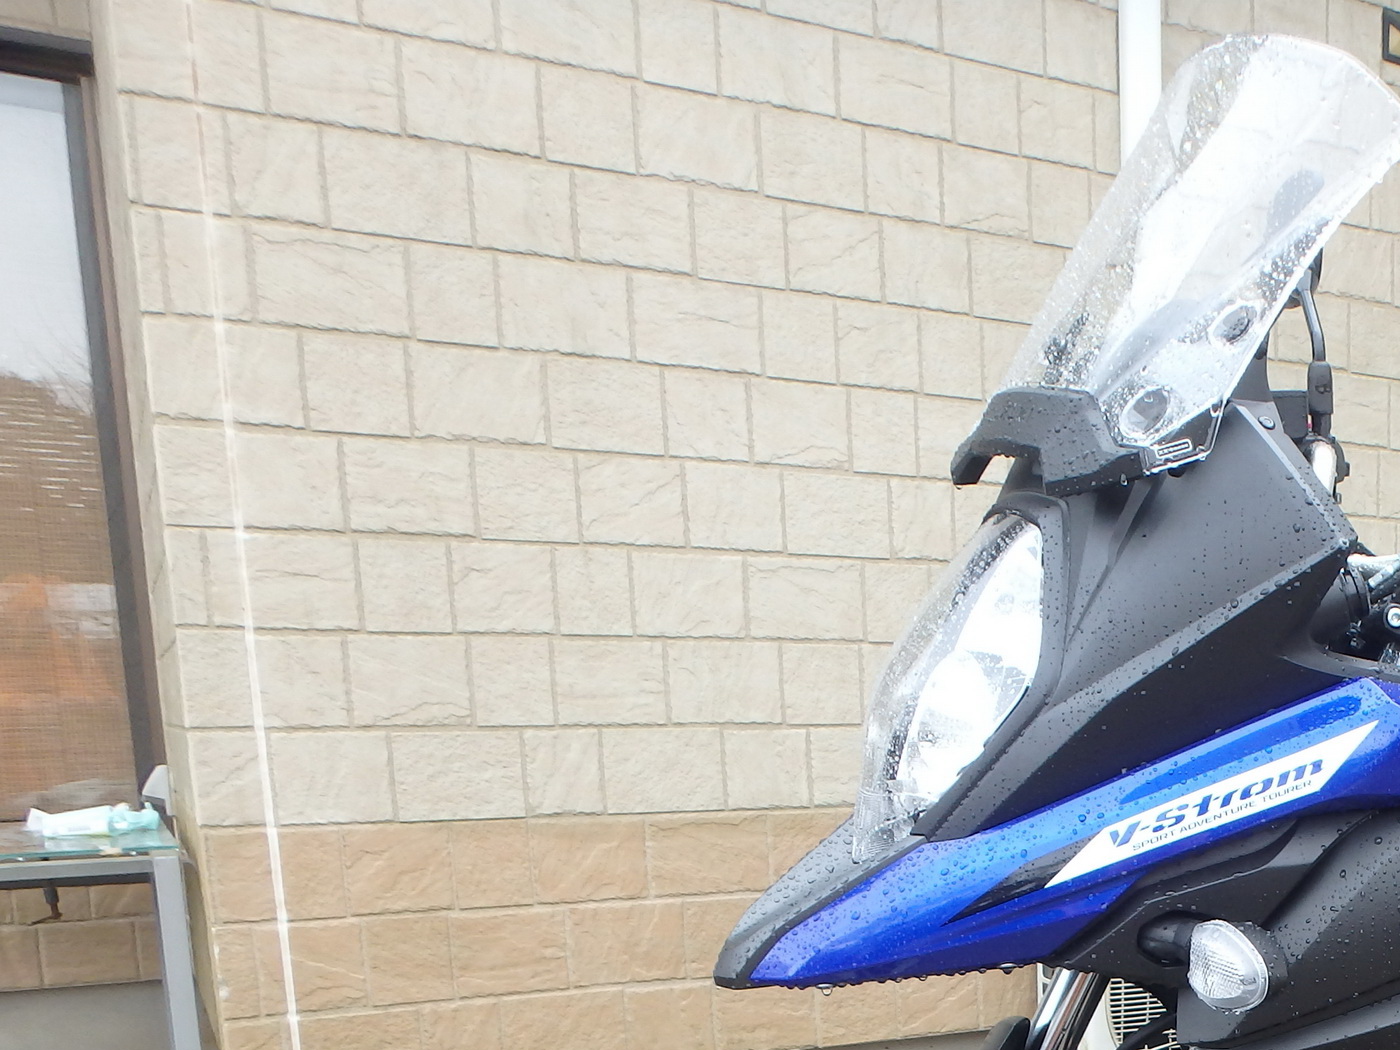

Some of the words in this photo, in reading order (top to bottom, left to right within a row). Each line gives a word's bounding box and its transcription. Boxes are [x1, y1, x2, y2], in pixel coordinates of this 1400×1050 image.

[1109, 758, 1324, 847] V-Strom
[1132, 830, 1175, 851] SPORT
[1179, 800, 1258, 834] ADVENTURE
[1262, 779, 1312, 803] TOURER
